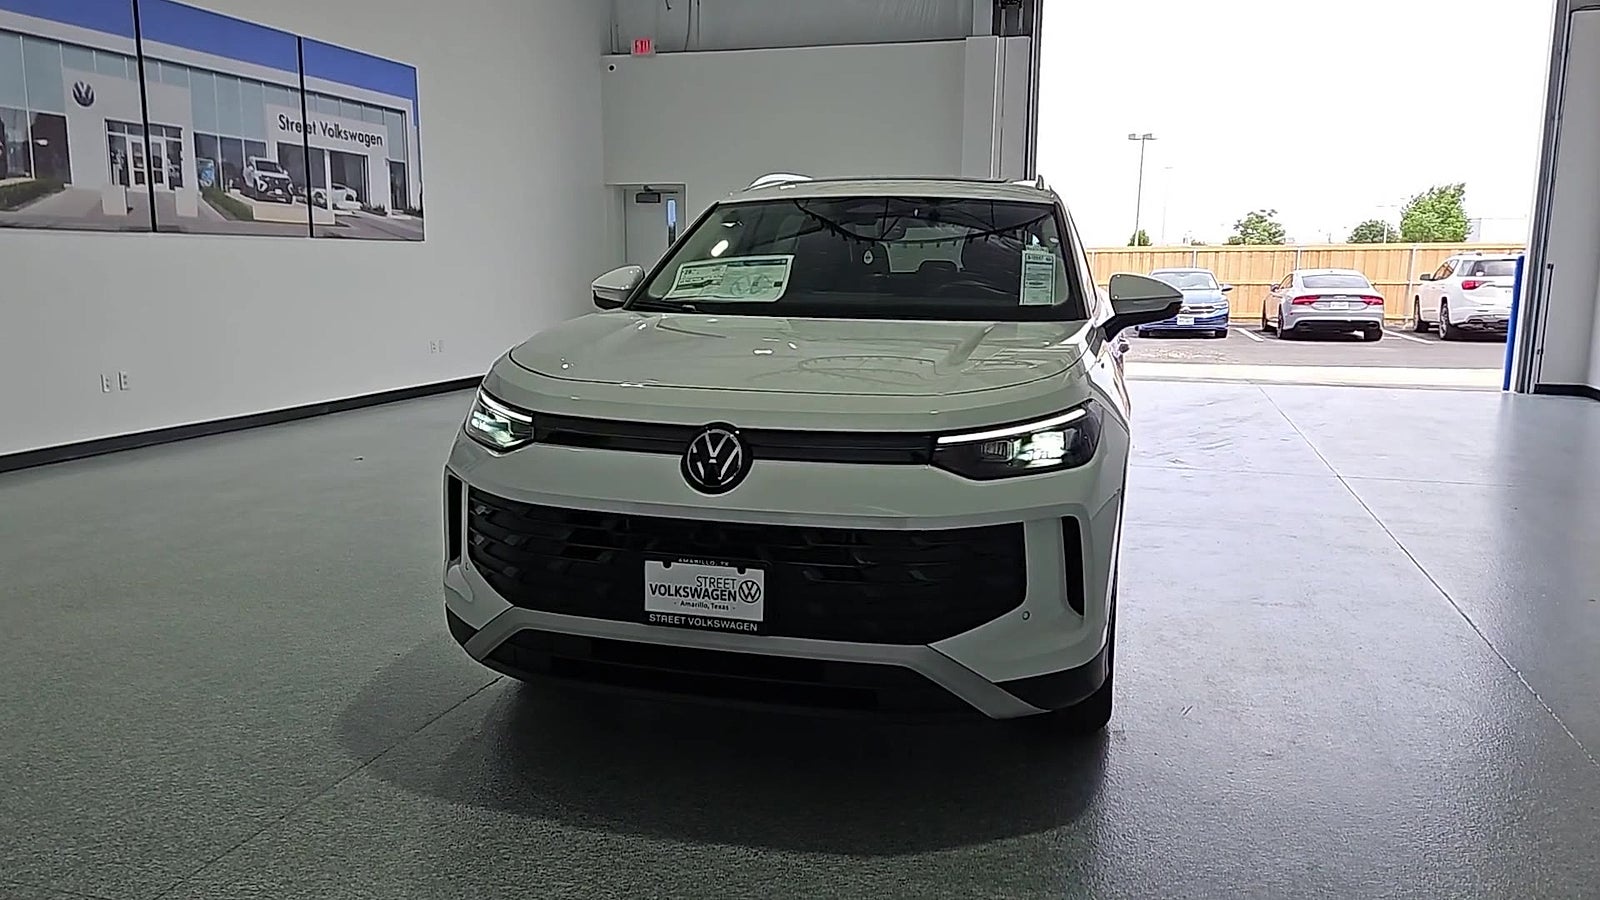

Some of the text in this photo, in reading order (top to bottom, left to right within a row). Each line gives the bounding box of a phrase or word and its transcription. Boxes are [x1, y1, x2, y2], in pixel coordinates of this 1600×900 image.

[278, 114, 383, 148] Street Volkswagen
[649, 583, 737, 602] VOLKSWAGEN
[696, 576, 737, 590] STREET
[680, 601, 729, 611] Amarillo, Texas
[649, 613, 758, 632] STREET VOLKSWAGEN
